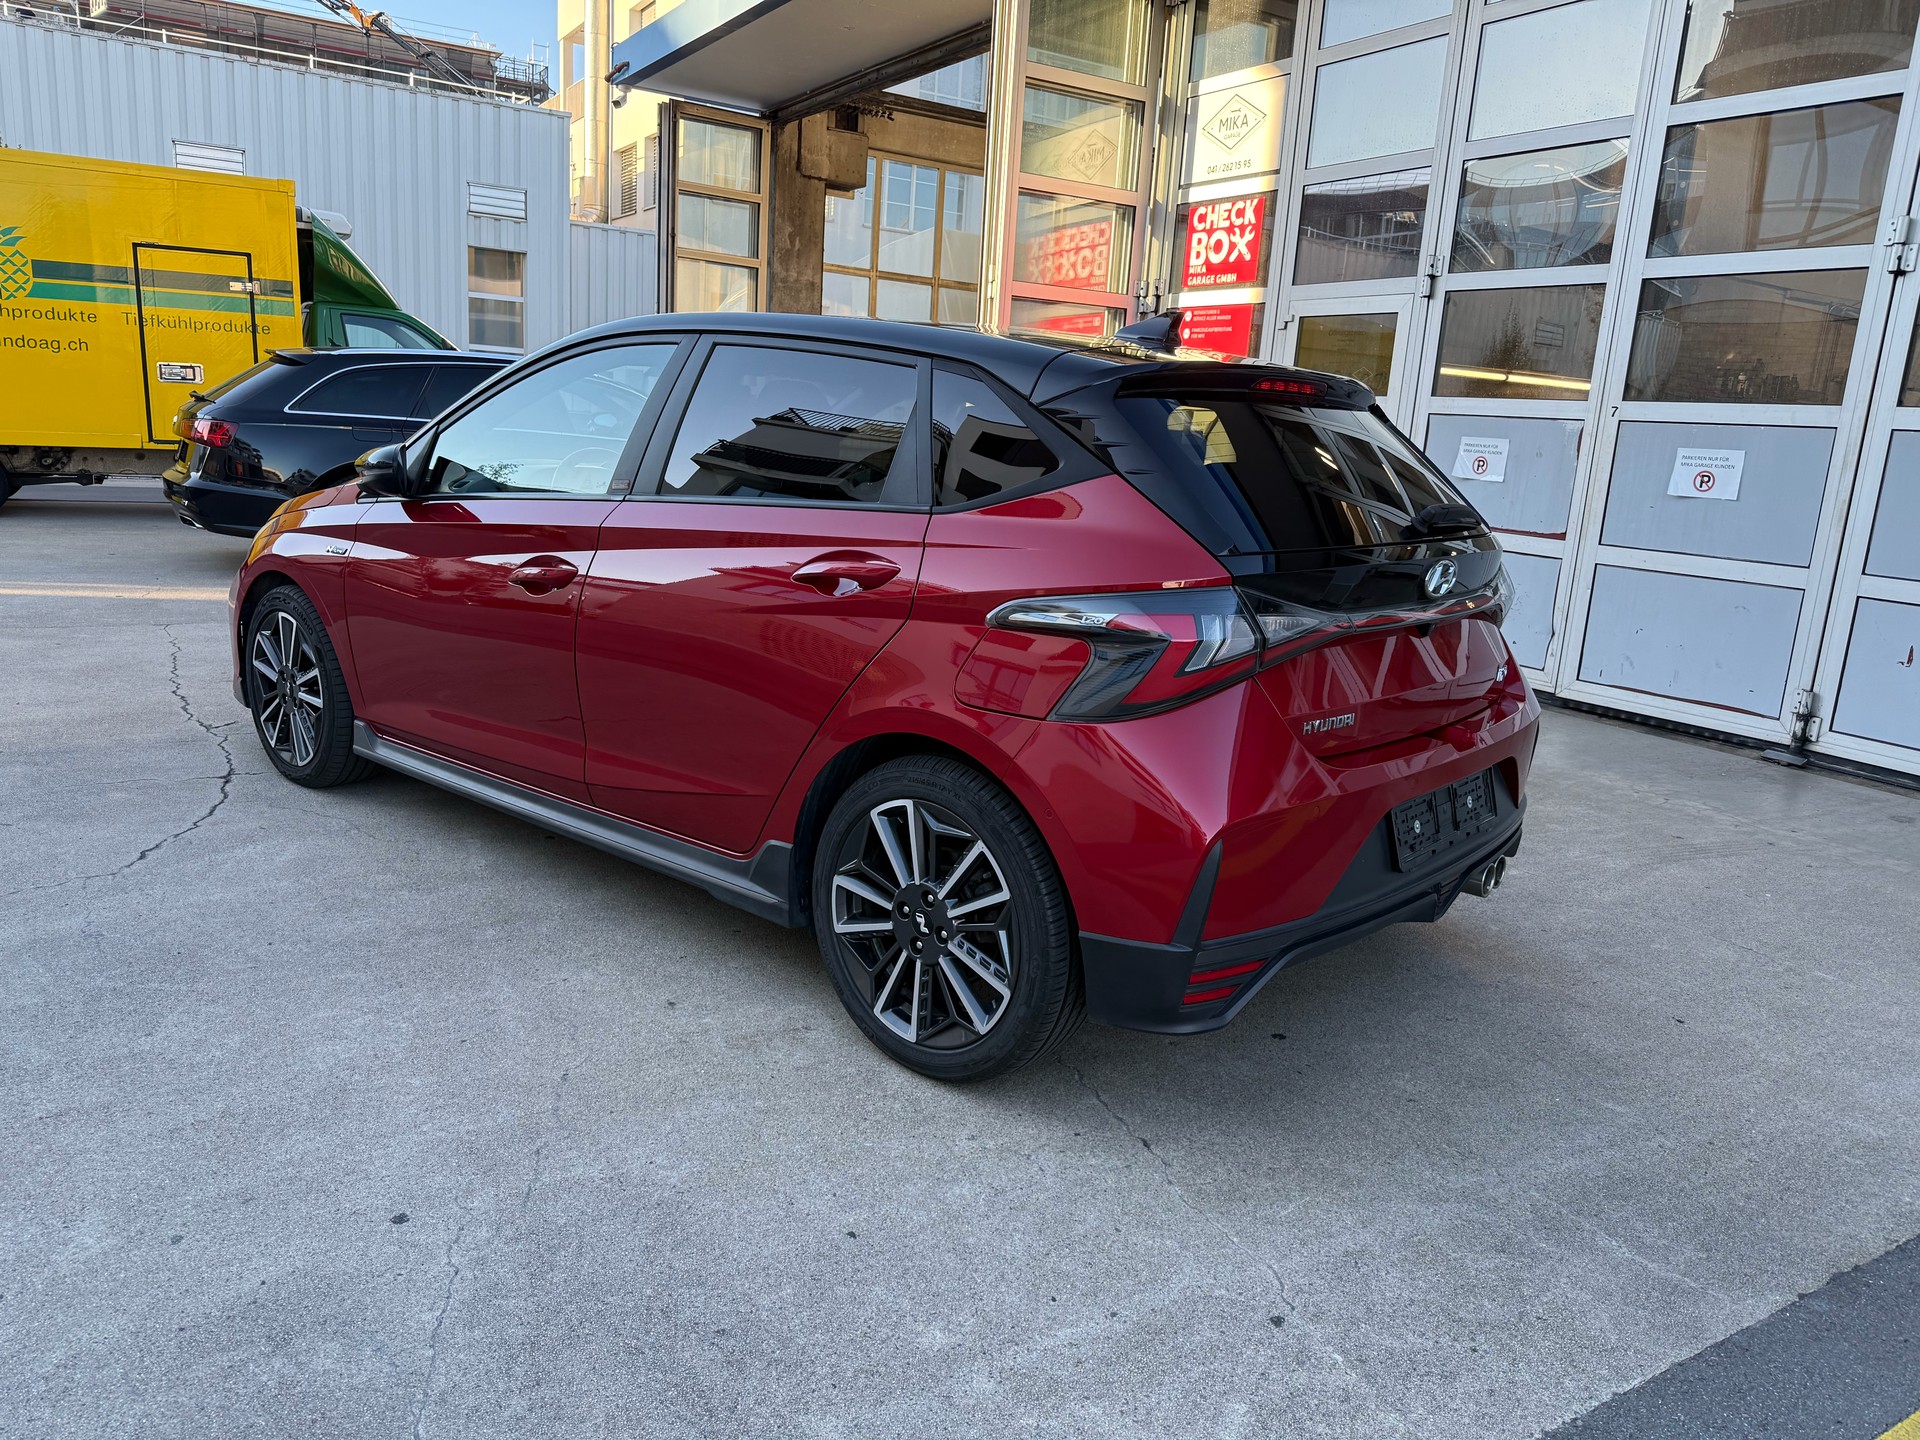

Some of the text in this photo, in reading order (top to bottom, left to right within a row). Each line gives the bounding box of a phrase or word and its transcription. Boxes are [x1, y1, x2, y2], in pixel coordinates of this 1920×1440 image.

[1218, 113, 1249, 133] MIKA
[1193, 198, 1259, 231] CHECK
[1190, 225, 1256, 266] BOX
[1187, 273, 1237, 286] GARAGE GMBH
[1188, 265, 1207, 275] MIKA
[121, 311, 271, 335] Tiefkühlprodukte
[0, 335, 89, 354] ndoag.ch
[1611, 406, 1619, 417] 7
[1719, 455, 1730, 463] FÜR
[292, 604, 314, 636] KUMHO
[1302, 713, 1355, 736] HYUNDAI
